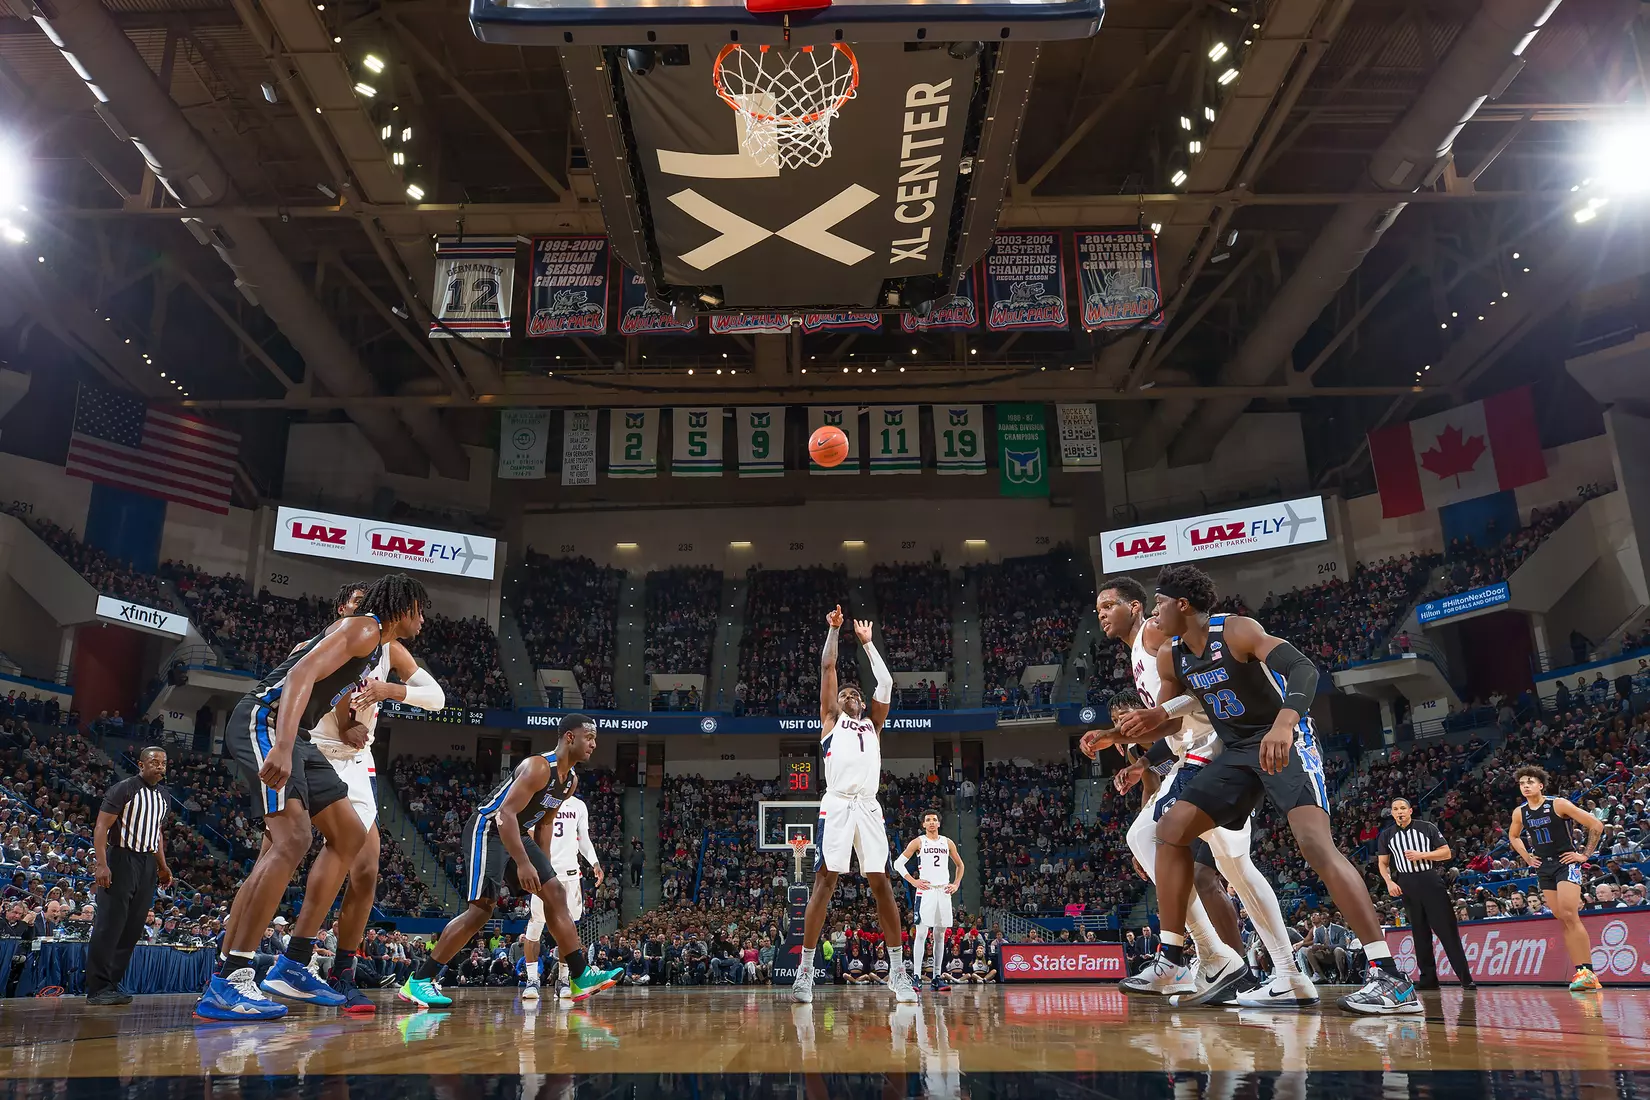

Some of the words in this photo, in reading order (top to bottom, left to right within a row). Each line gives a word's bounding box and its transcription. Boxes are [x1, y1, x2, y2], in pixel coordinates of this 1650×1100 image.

[995, 235, 1053, 245] 2003-2004
[1085, 235, 1145, 243] 2014-2015
[538, 240, 604, 251] 1999-2000
[997, 245, 1050, 254] EASTERN
[1080, 243, 1151, 253] NORTHEAST
[542, 252, 597, 263] REGULAR
[989, 255, 1057, 265] CONFERENCE
[1090, 252, 1143, 261] DIVISION
[546, 264, 593, 275] SEASON
[989, 265, 1057, 275] CHAMPIONS
[1083, 260, 1152, 270] CHAMPIONS
[534, 276, 603, 287] CHAMPIONS
[447, 278, 499, 312] 12
[625, 433, 642, 460] 2
[688, 431, 707, 457] 5
[752, 431, 770, 459] 9
[880, 429, 909, 454] 11
[943, 429, 976, 458] 19
[1068, 447, 1076, 455] 18
[13, 501, 34, 514] 231
[292, 522, 347, 545] LAZ
[1190, 522, 1246, 546] LAZ
[1251, 517, 1285, 536] FLY
[371, 533, 426, 556] LAZ
[428, 544, 462, 561] FLY
[560, 544, 575, 552] 234
[678, 543, 693, 552] 235
[789, 542, 804, 551] 236
[901, 541, 916, 549] 237
[1116, 535, 1167, 558] LAZ
[1193, 542, 1224, 552] AIRPORT
[1226, 537, 1258, 547] PARKING
[372, 550, 402, 560] AIRPORT
[404, 554, 435, 564] PARKING
[1134, 551, 1167, 560] PARKING
[1318, 561, 1337, 575] 240
[270, 573, 289, 585] 232
[1442, 587, 1505, 608] #HiltonNextDoor
[1454, 603, 1472, 611] DEALS
[1485, 594, 1506, 604] OFFERS
[120, 604, 168, 628] xfinity
[1420, 609, 1441, 619] Hilton
[1187, 667, 1230, 690] Tigers
[391, 702, 401, 711] 16
[1203, 689, 1245, 720] 23
[1421, 700, 1437, 709] 112
[168, 711, 185, 720] 107
[469, 711, 484, 719] 3:42
[600, 719, 619, 729] FAN
[621, 720, 648, 729] SHOP
[779, 720, 806, 729] VISIT
[893, 719, 931, 728] ATRIUM
[857, 733, 864, 752] 1
[791, 762, 811, 772] 4:23
[789, 773, 809, 790] 30
[523, 811, 546, 828] 2
[1533, 828, 1553, 844] 11
[933, 855, 940, 866] 2
[774, 968, 826, 978] TRAVRS
